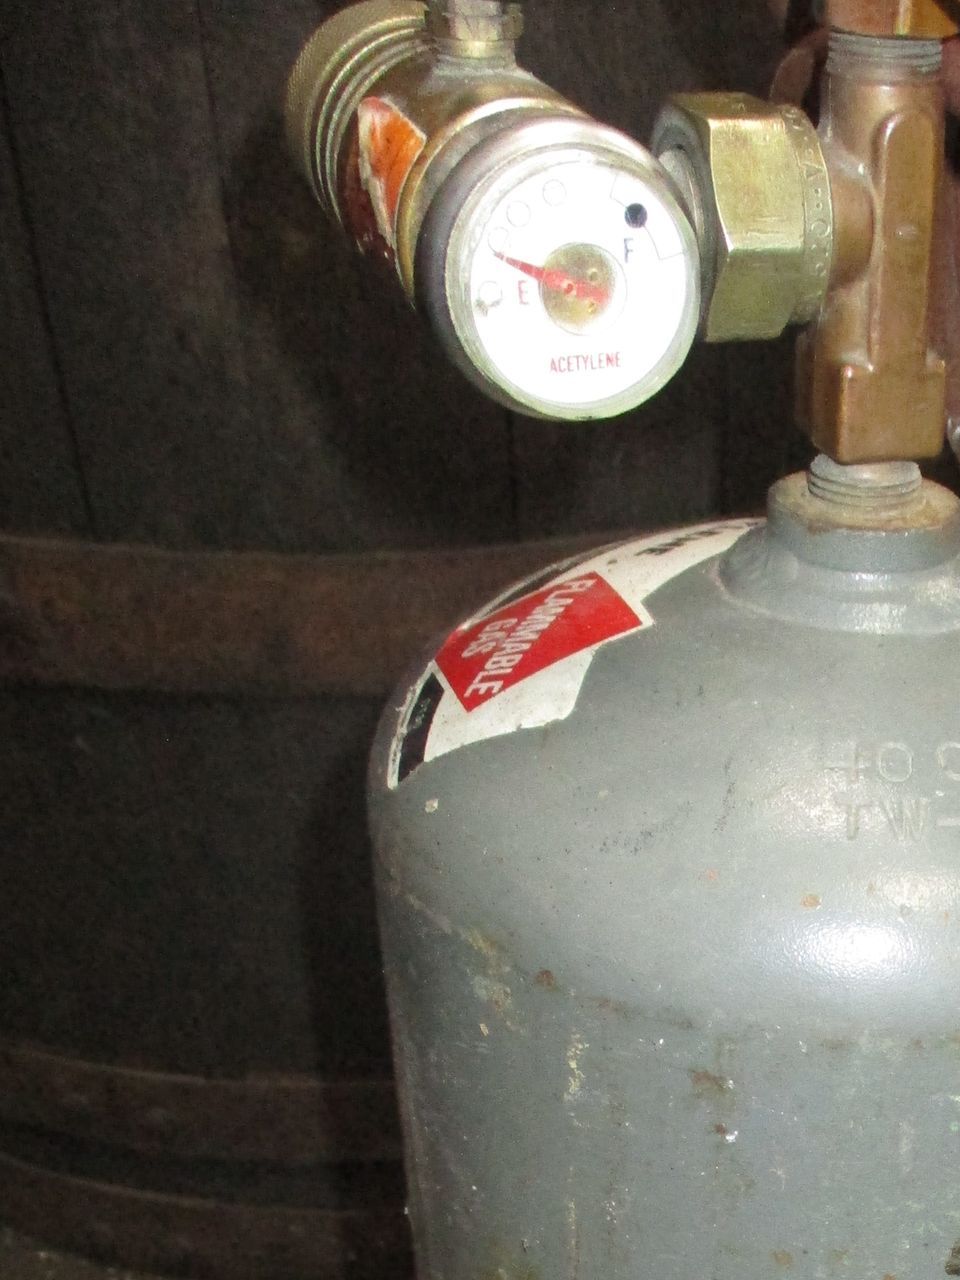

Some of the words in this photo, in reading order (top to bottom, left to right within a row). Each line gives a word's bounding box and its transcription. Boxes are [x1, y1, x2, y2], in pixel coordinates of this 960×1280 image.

[623, 238, 634, 264] F
[517, 279, 529, 305] E
[549, 351, 622, 374] ACETYLENE
[460, 617, 519, 659] GAS
[462, 578, 599, 698] FLAMMABLE
